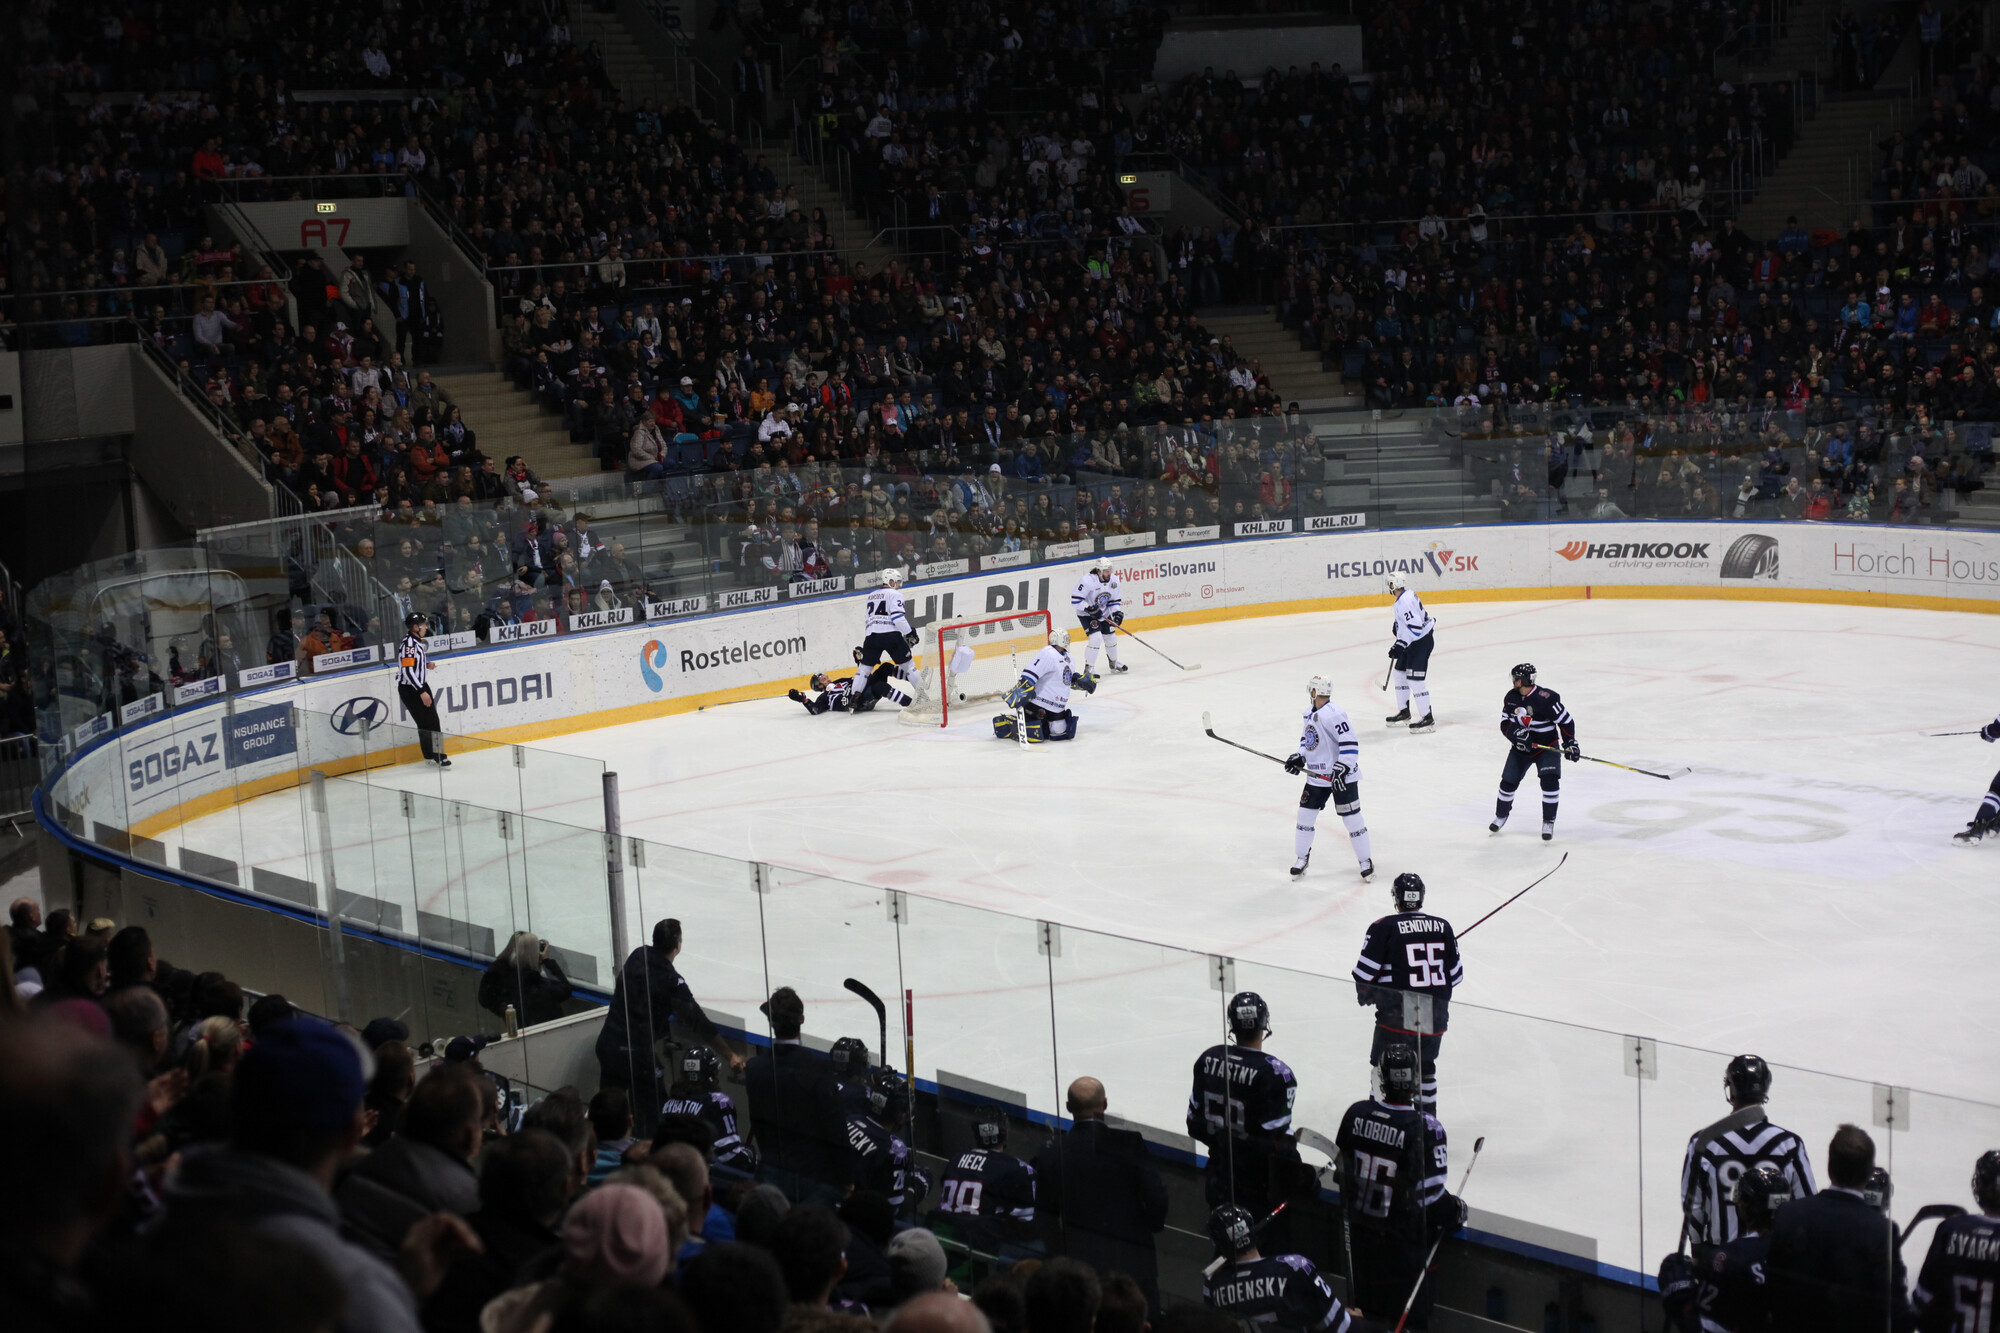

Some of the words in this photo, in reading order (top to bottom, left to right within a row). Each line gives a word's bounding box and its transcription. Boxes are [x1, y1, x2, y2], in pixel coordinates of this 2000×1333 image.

[300, 218, 351, 248] A7
[1241, 521, 1286, 534] KHL.RU
[1312, 515, 1358, 528] KHL.RU
[1115, 561, 1216, 583] #VerniSlovanu
[1608, 559, 1655, 569] driving
[1657, 560, 1710, 569] emotion
[796, 578, 839, 595] KHL.RU
[727, 589, 770, 606] KHL.RU
[654, 598, 700, 616] KHL.RU
[1404, 610, 1414, 621] 21
[577, 610, 626, 628] KHL.RU
[498, 621, 548, 640] KHL.RU
[433, 636, 468, 648] ERIELL
[321, 654, 351, 665] SOGAZ
[681, 635, 807, 673] Rostelecom
[247, 670, 274, 681] SOGAZ
[1335, 721, 1350, 735] 20
[243, 734, 276, 751] GROUP
[129, 732, 220, 792] SOGAZ
[1397, 919, 1445, 935] GENOWAY
[1405, 942, 1447, 988] 55
[1352, 1116, 1406, 1150] SLOBODA
[957, 1153, 988, 1172] HECL
